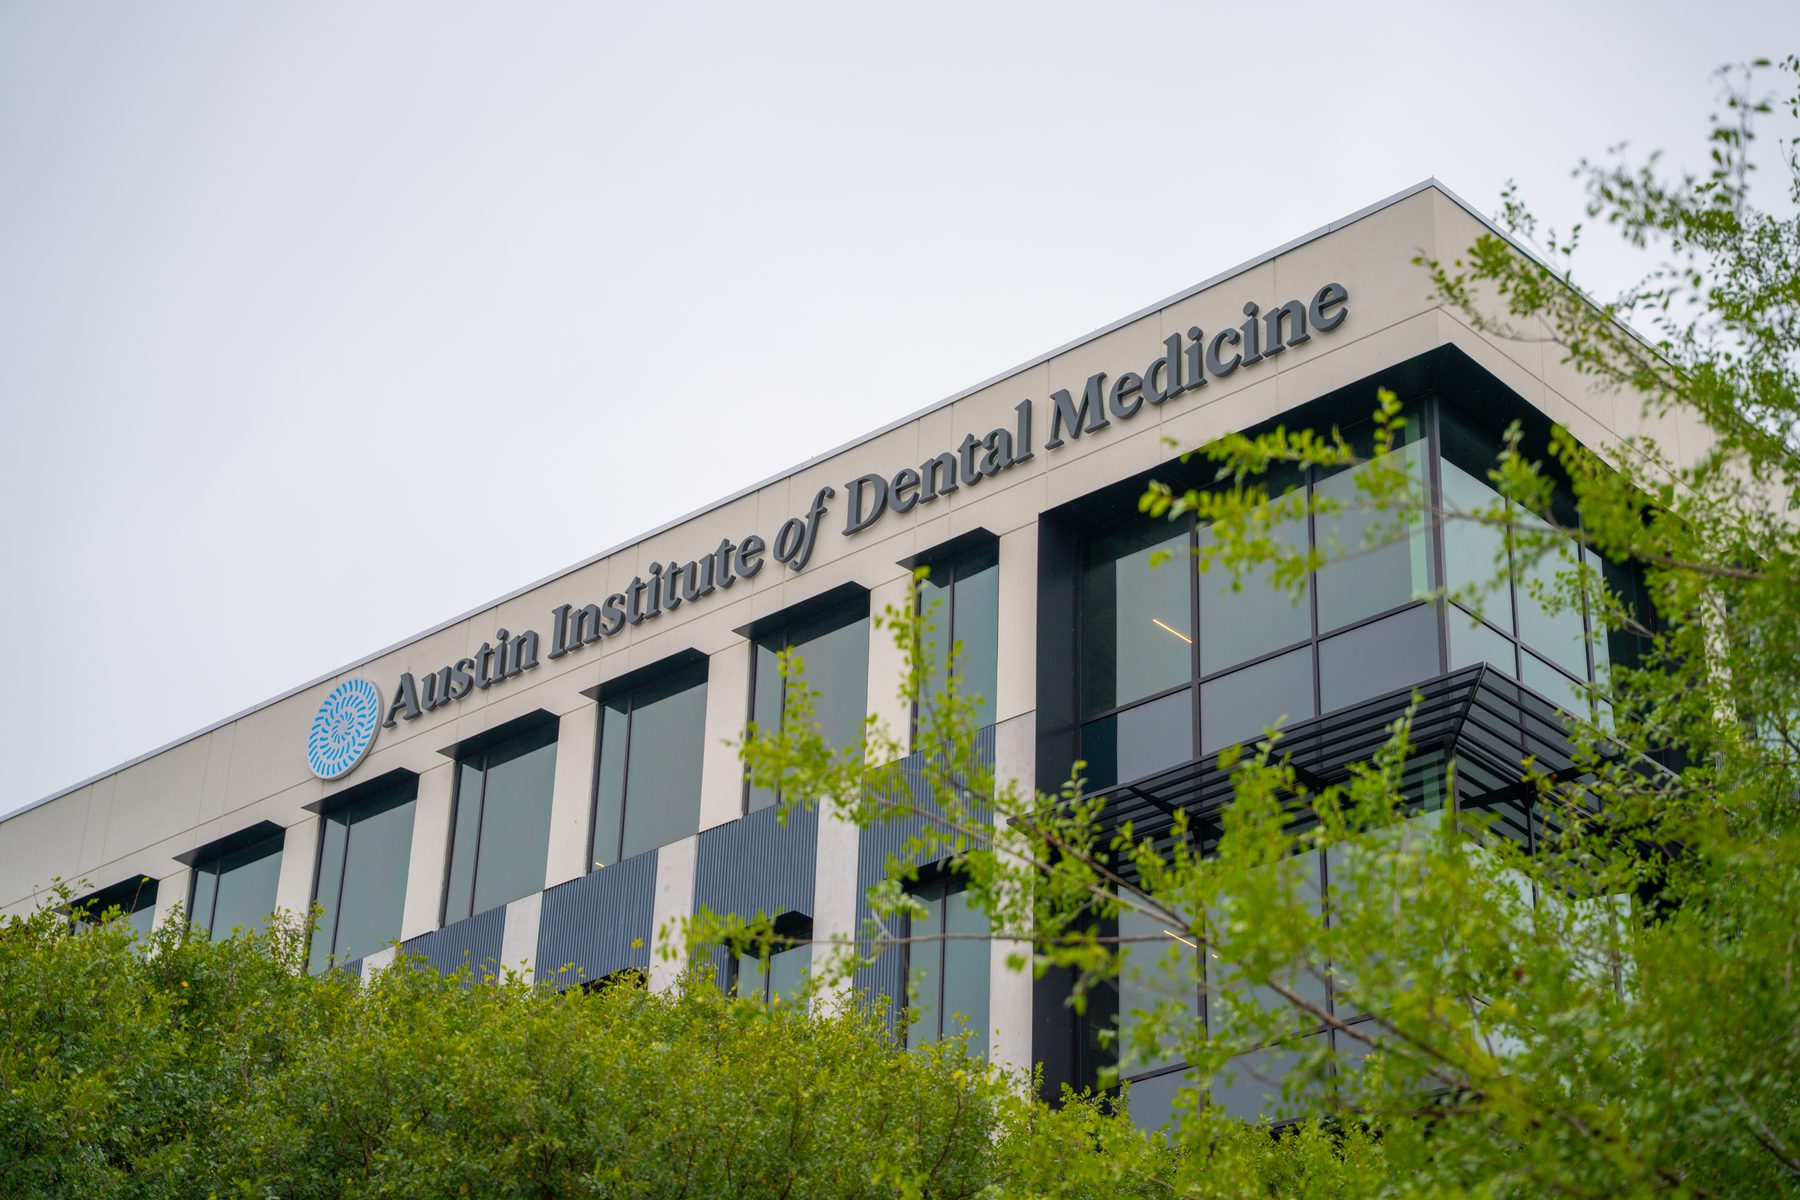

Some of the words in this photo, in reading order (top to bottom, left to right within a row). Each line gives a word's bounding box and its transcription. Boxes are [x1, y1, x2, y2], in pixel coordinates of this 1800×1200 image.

[382, 627, 539, 728] Austin
[547, 533, 766, 660] Institute
[773, 486, 836, 572] of
[841, 398, 1035, 537] Dental
[1044, 282, 1349, 451] Medicine
